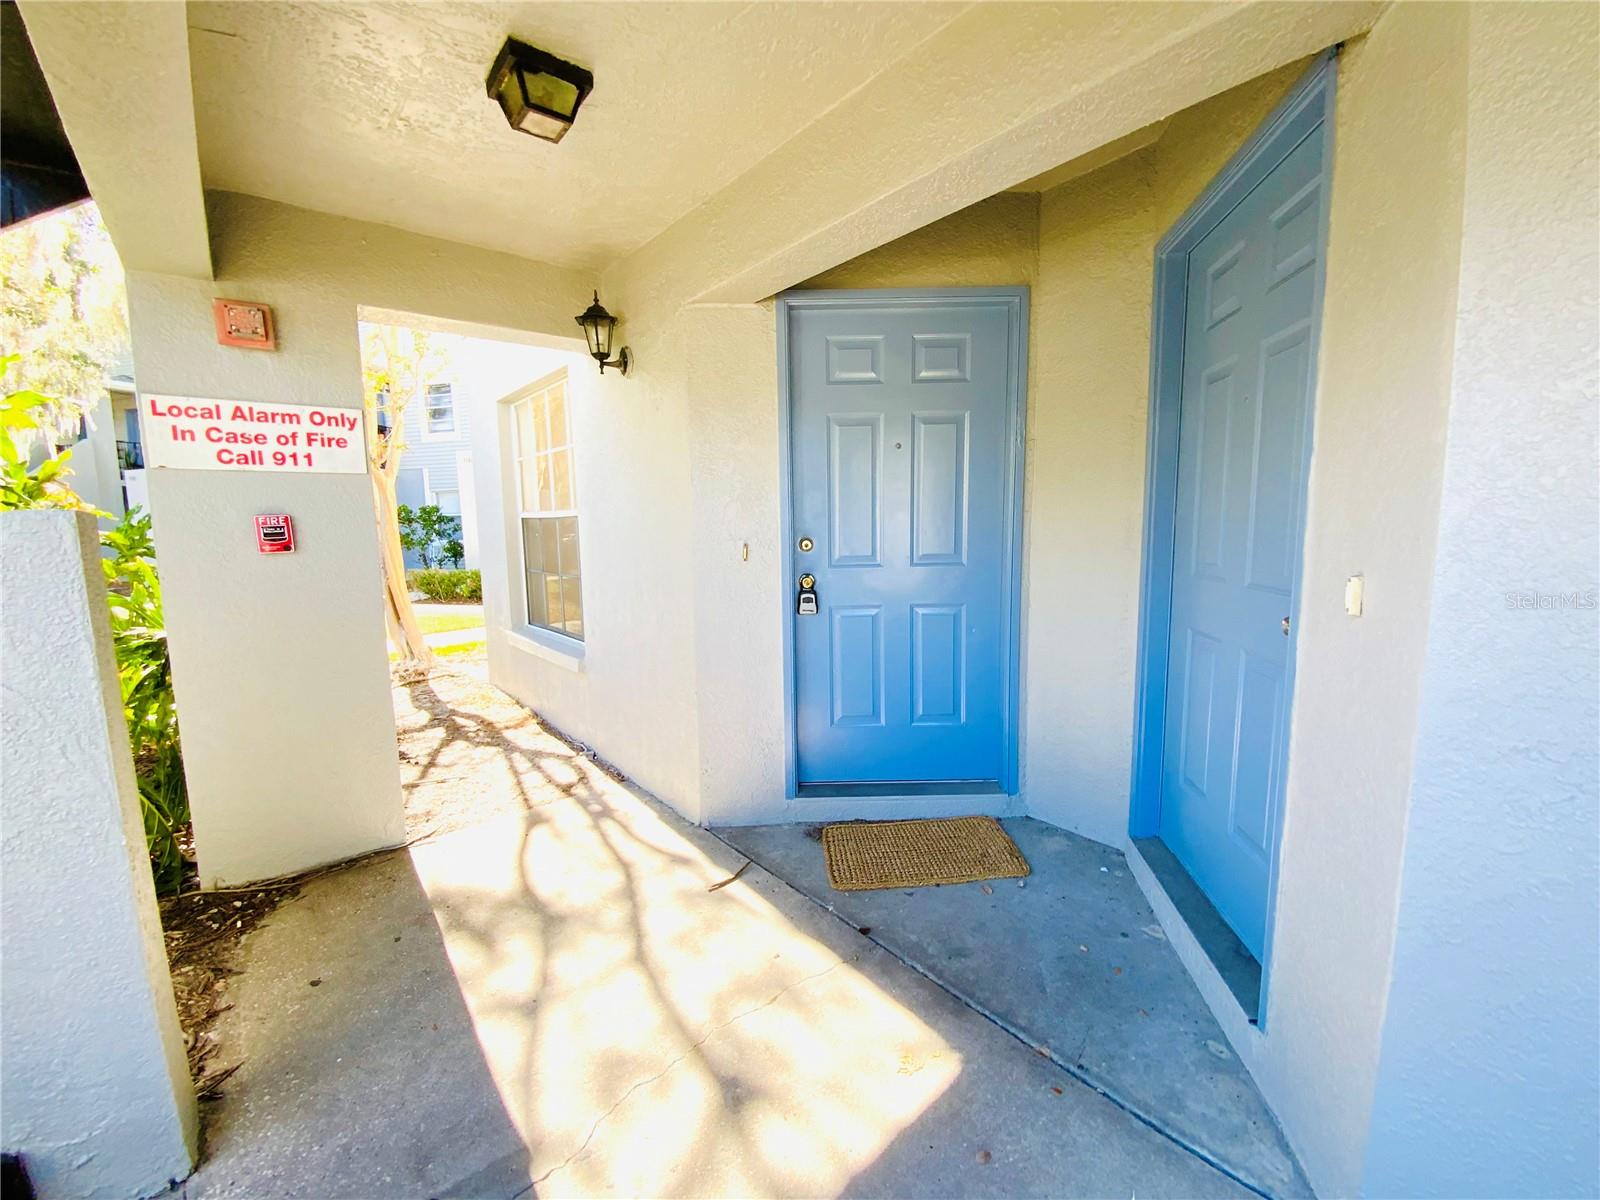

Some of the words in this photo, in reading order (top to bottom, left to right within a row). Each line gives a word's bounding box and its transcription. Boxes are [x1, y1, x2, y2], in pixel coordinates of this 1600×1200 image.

[150, 399, 222, 420] Local
[231, 405, 302, 425] Alarm
[308, 411, 358, 431] Only
[171, 424, 196, 442] In
[204, 426, 267, 445] Case
[275, 433, 298, 447] of
[306, 432, 348, 449] Fire
[216, 448, 265, 465] Call
[271, 452, 313, 467] 911
[258, 516, 286, 525] FIRE
